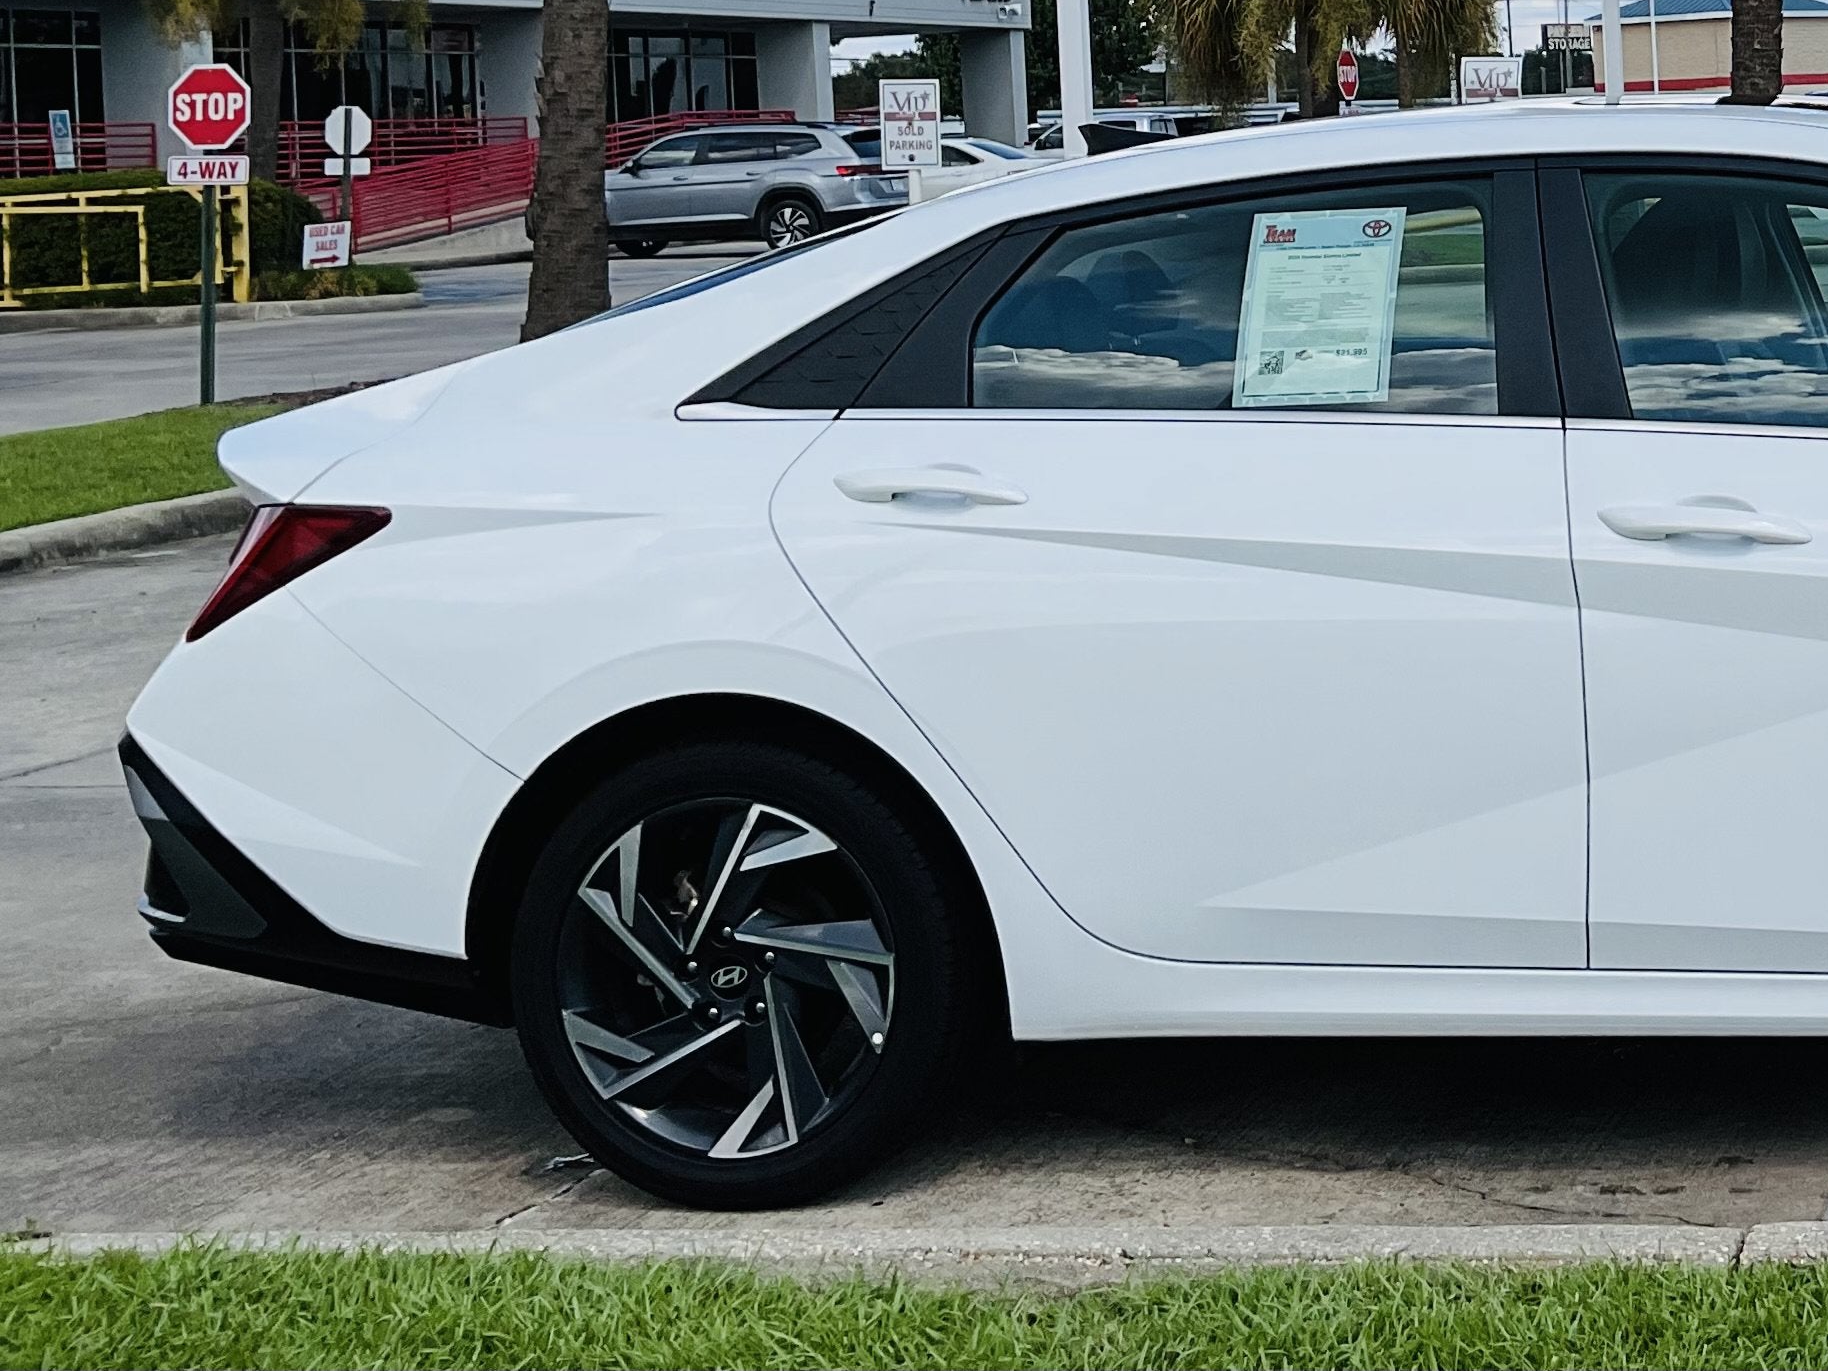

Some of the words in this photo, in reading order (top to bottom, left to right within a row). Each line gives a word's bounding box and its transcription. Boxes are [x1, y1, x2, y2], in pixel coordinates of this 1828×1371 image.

[1339, 65, 1356, 83] STOP
[175, 92, 243, 122] STOP
[897, 126, 925, 136] SOLD
[889, 140, 933, 151] PARKING
[177, 161, 240, 180] 4-WAY
[309, 225, 329, 238] USED
[330, 223, 346, 236] CAR
